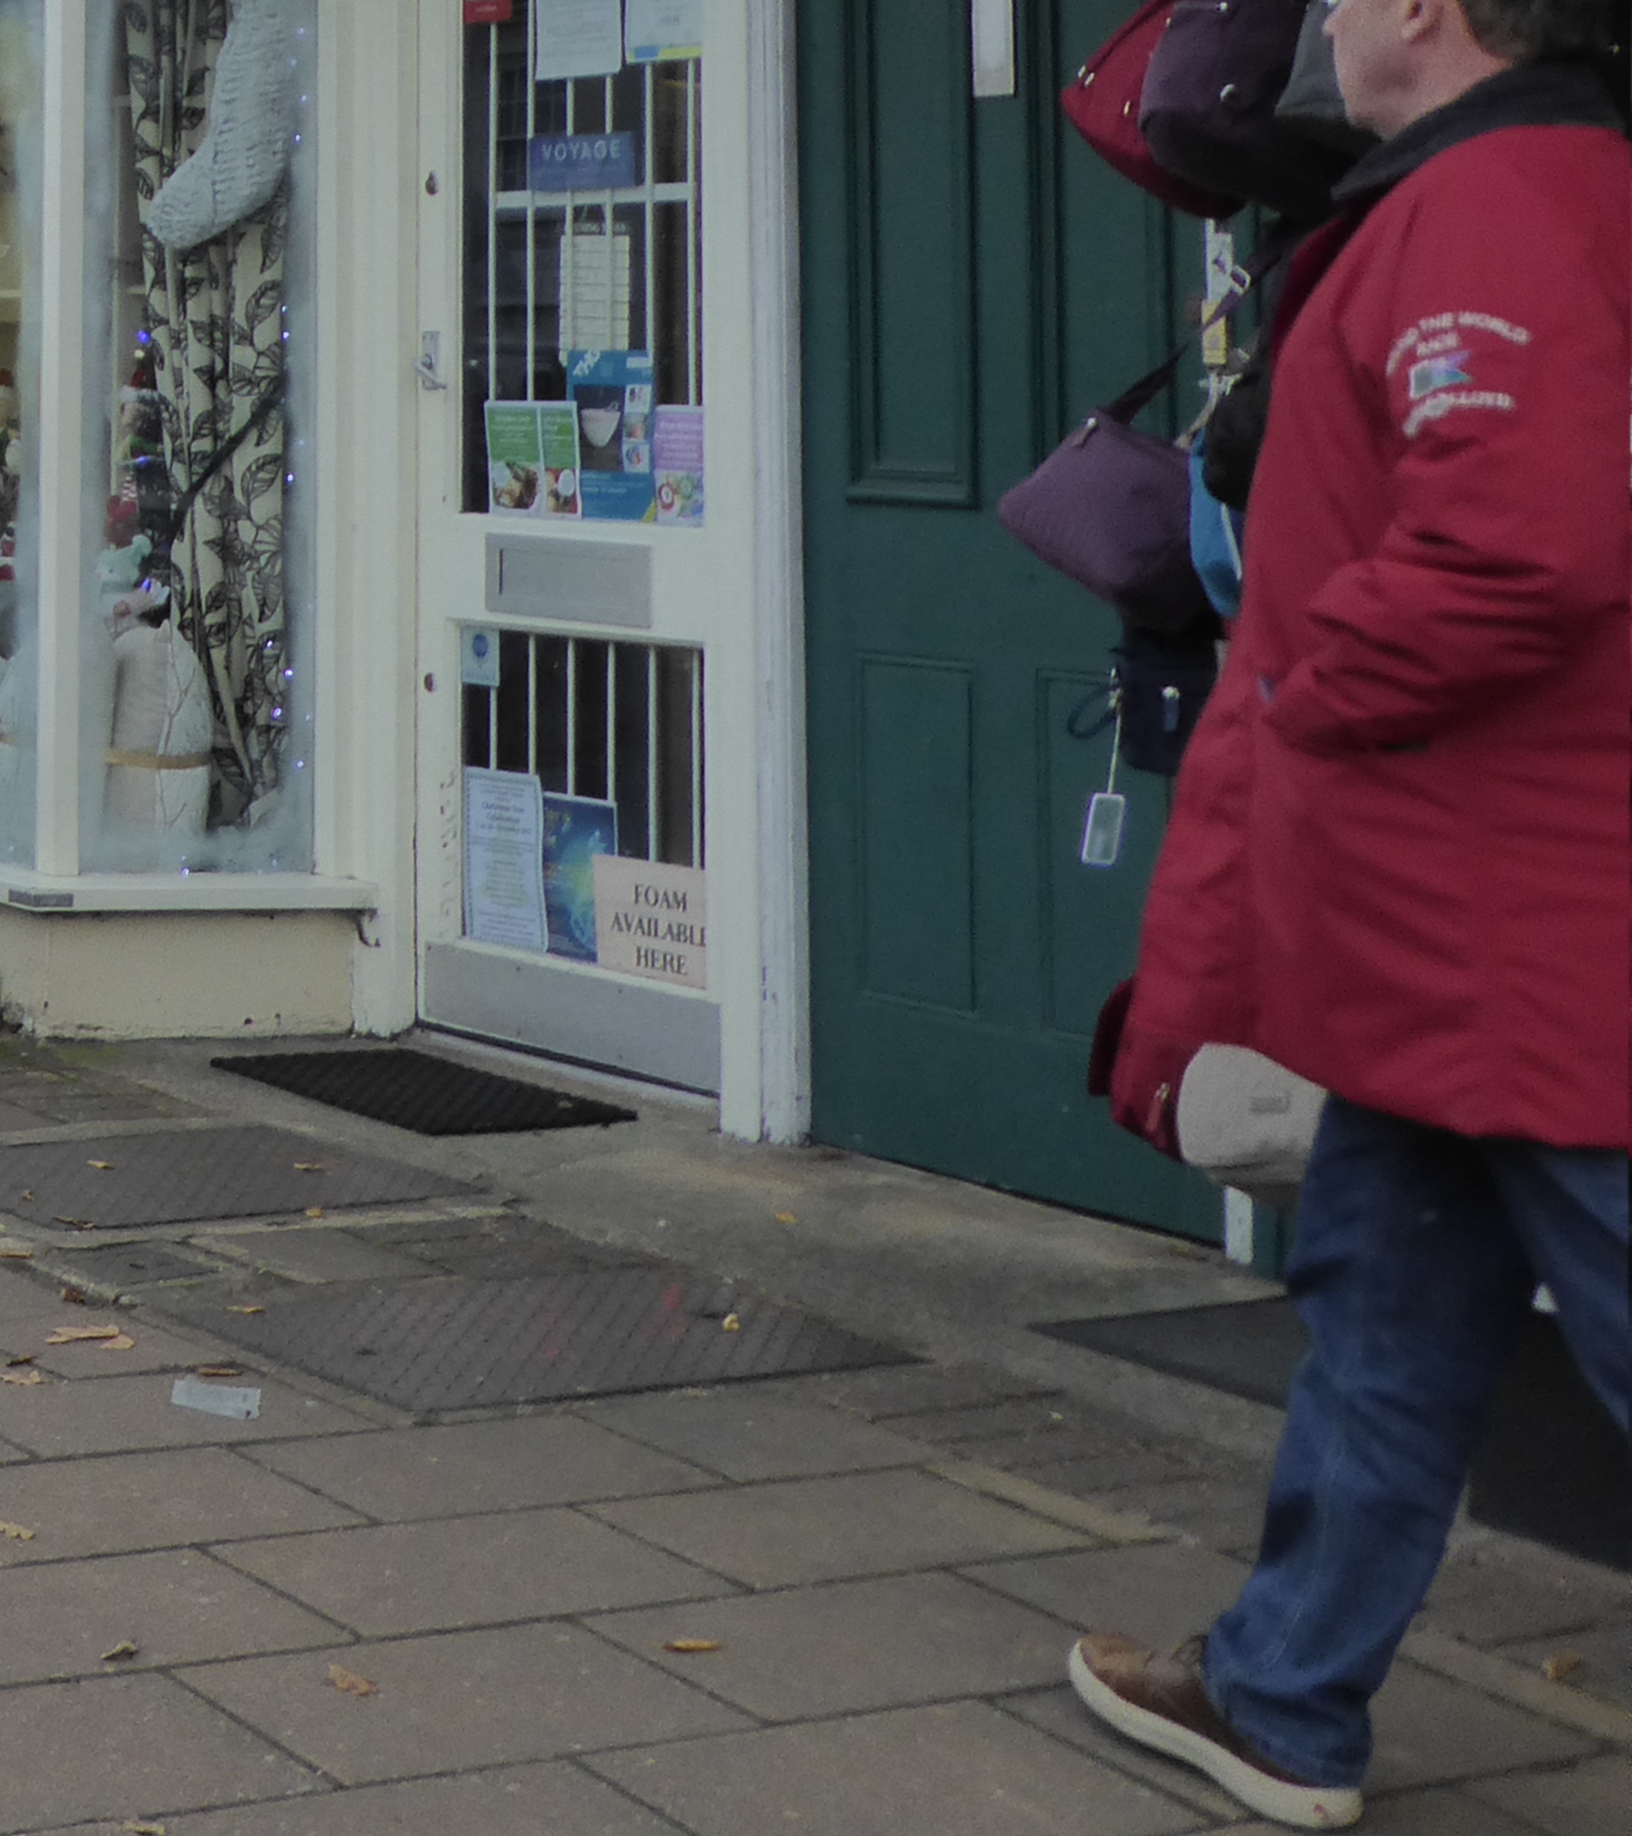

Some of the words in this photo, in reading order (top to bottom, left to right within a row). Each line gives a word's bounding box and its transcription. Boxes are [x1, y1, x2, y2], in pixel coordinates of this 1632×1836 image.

[542, 140, 621, 162] VOYAGE
[633, 883, 688, 913] FOAM
[636, 944, 688, 977] HERE
